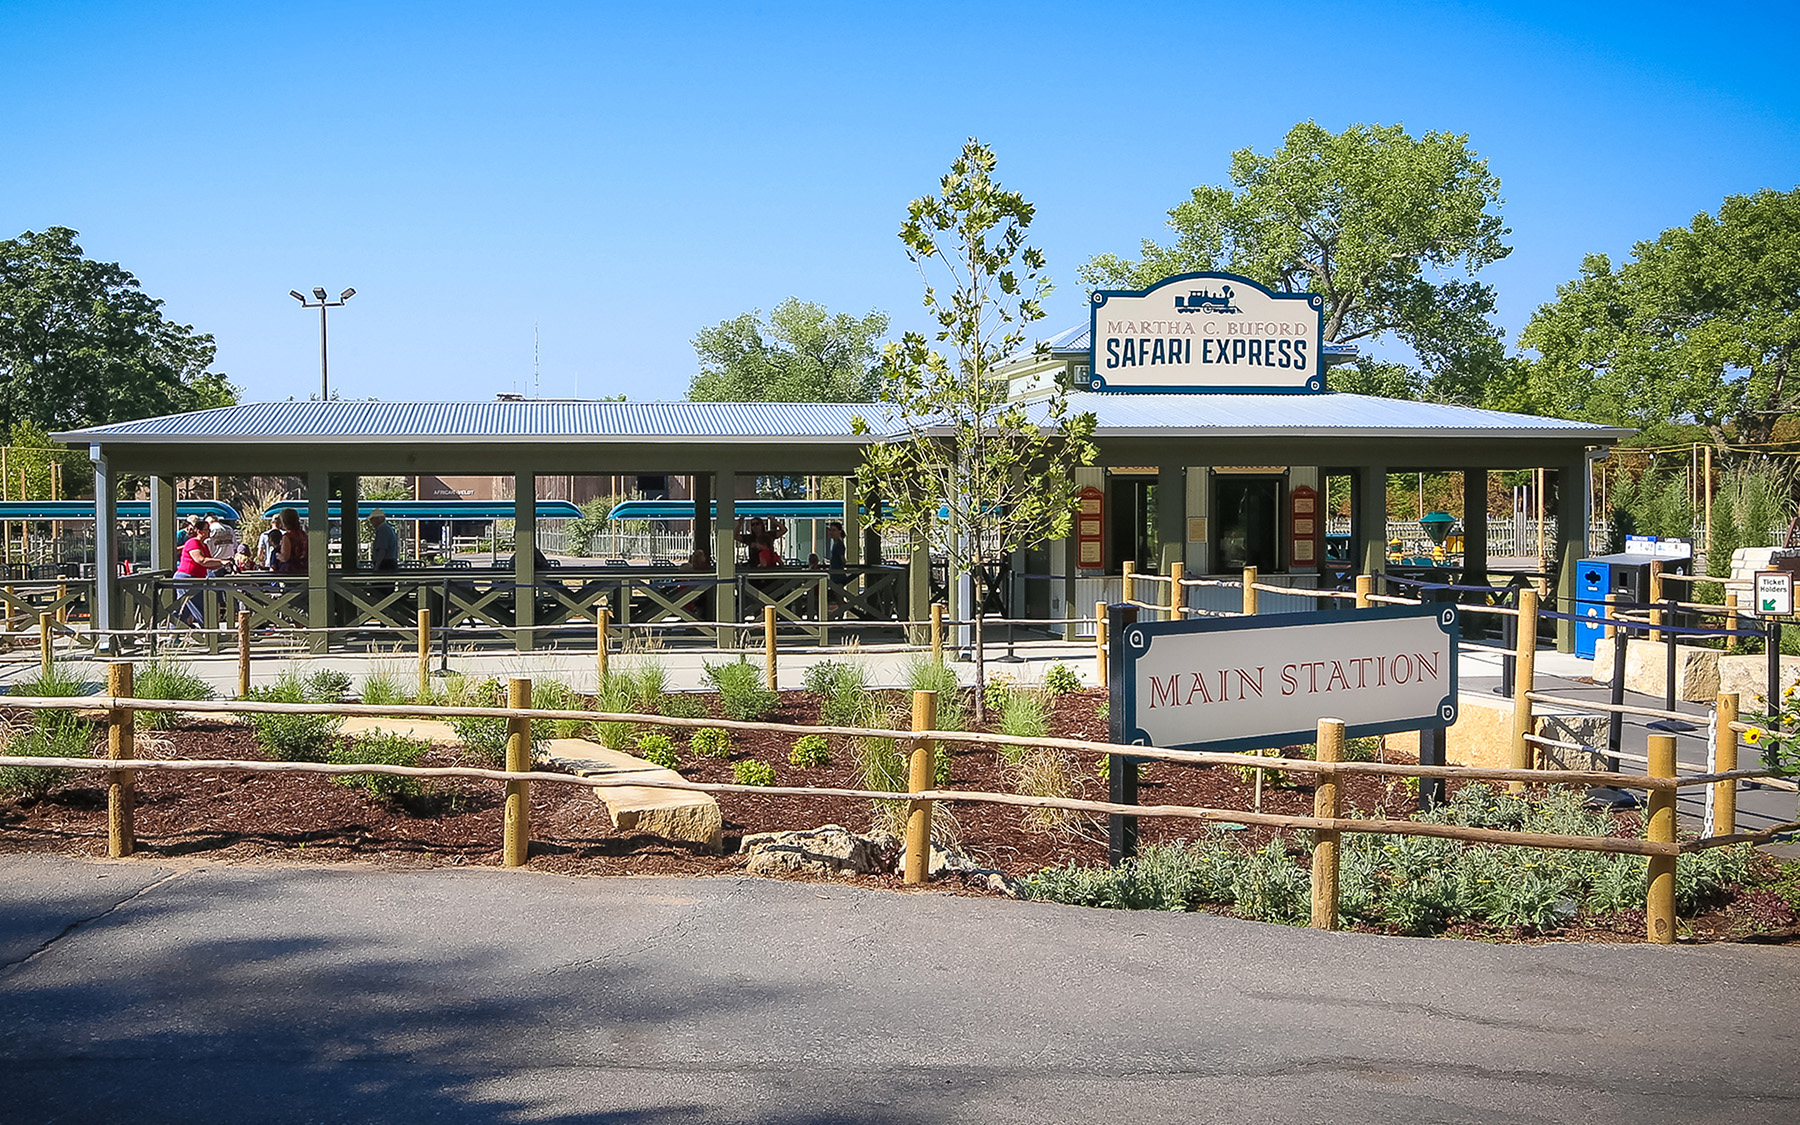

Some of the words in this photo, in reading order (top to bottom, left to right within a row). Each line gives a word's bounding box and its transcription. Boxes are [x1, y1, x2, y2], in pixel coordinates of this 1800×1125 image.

[1107, 321, 1196, 335] MARTHA
[1203, 322, 1220, 334] C.
[1227, 322, 1308, 336] BUFORD
[1106, 338, 1191, 369] SAFARI
[1202, 339, 1307, 370] EXPRESS
[1149, 666, 1265, 709] MAIN
[1281, 651, 1440, 696] STATION
